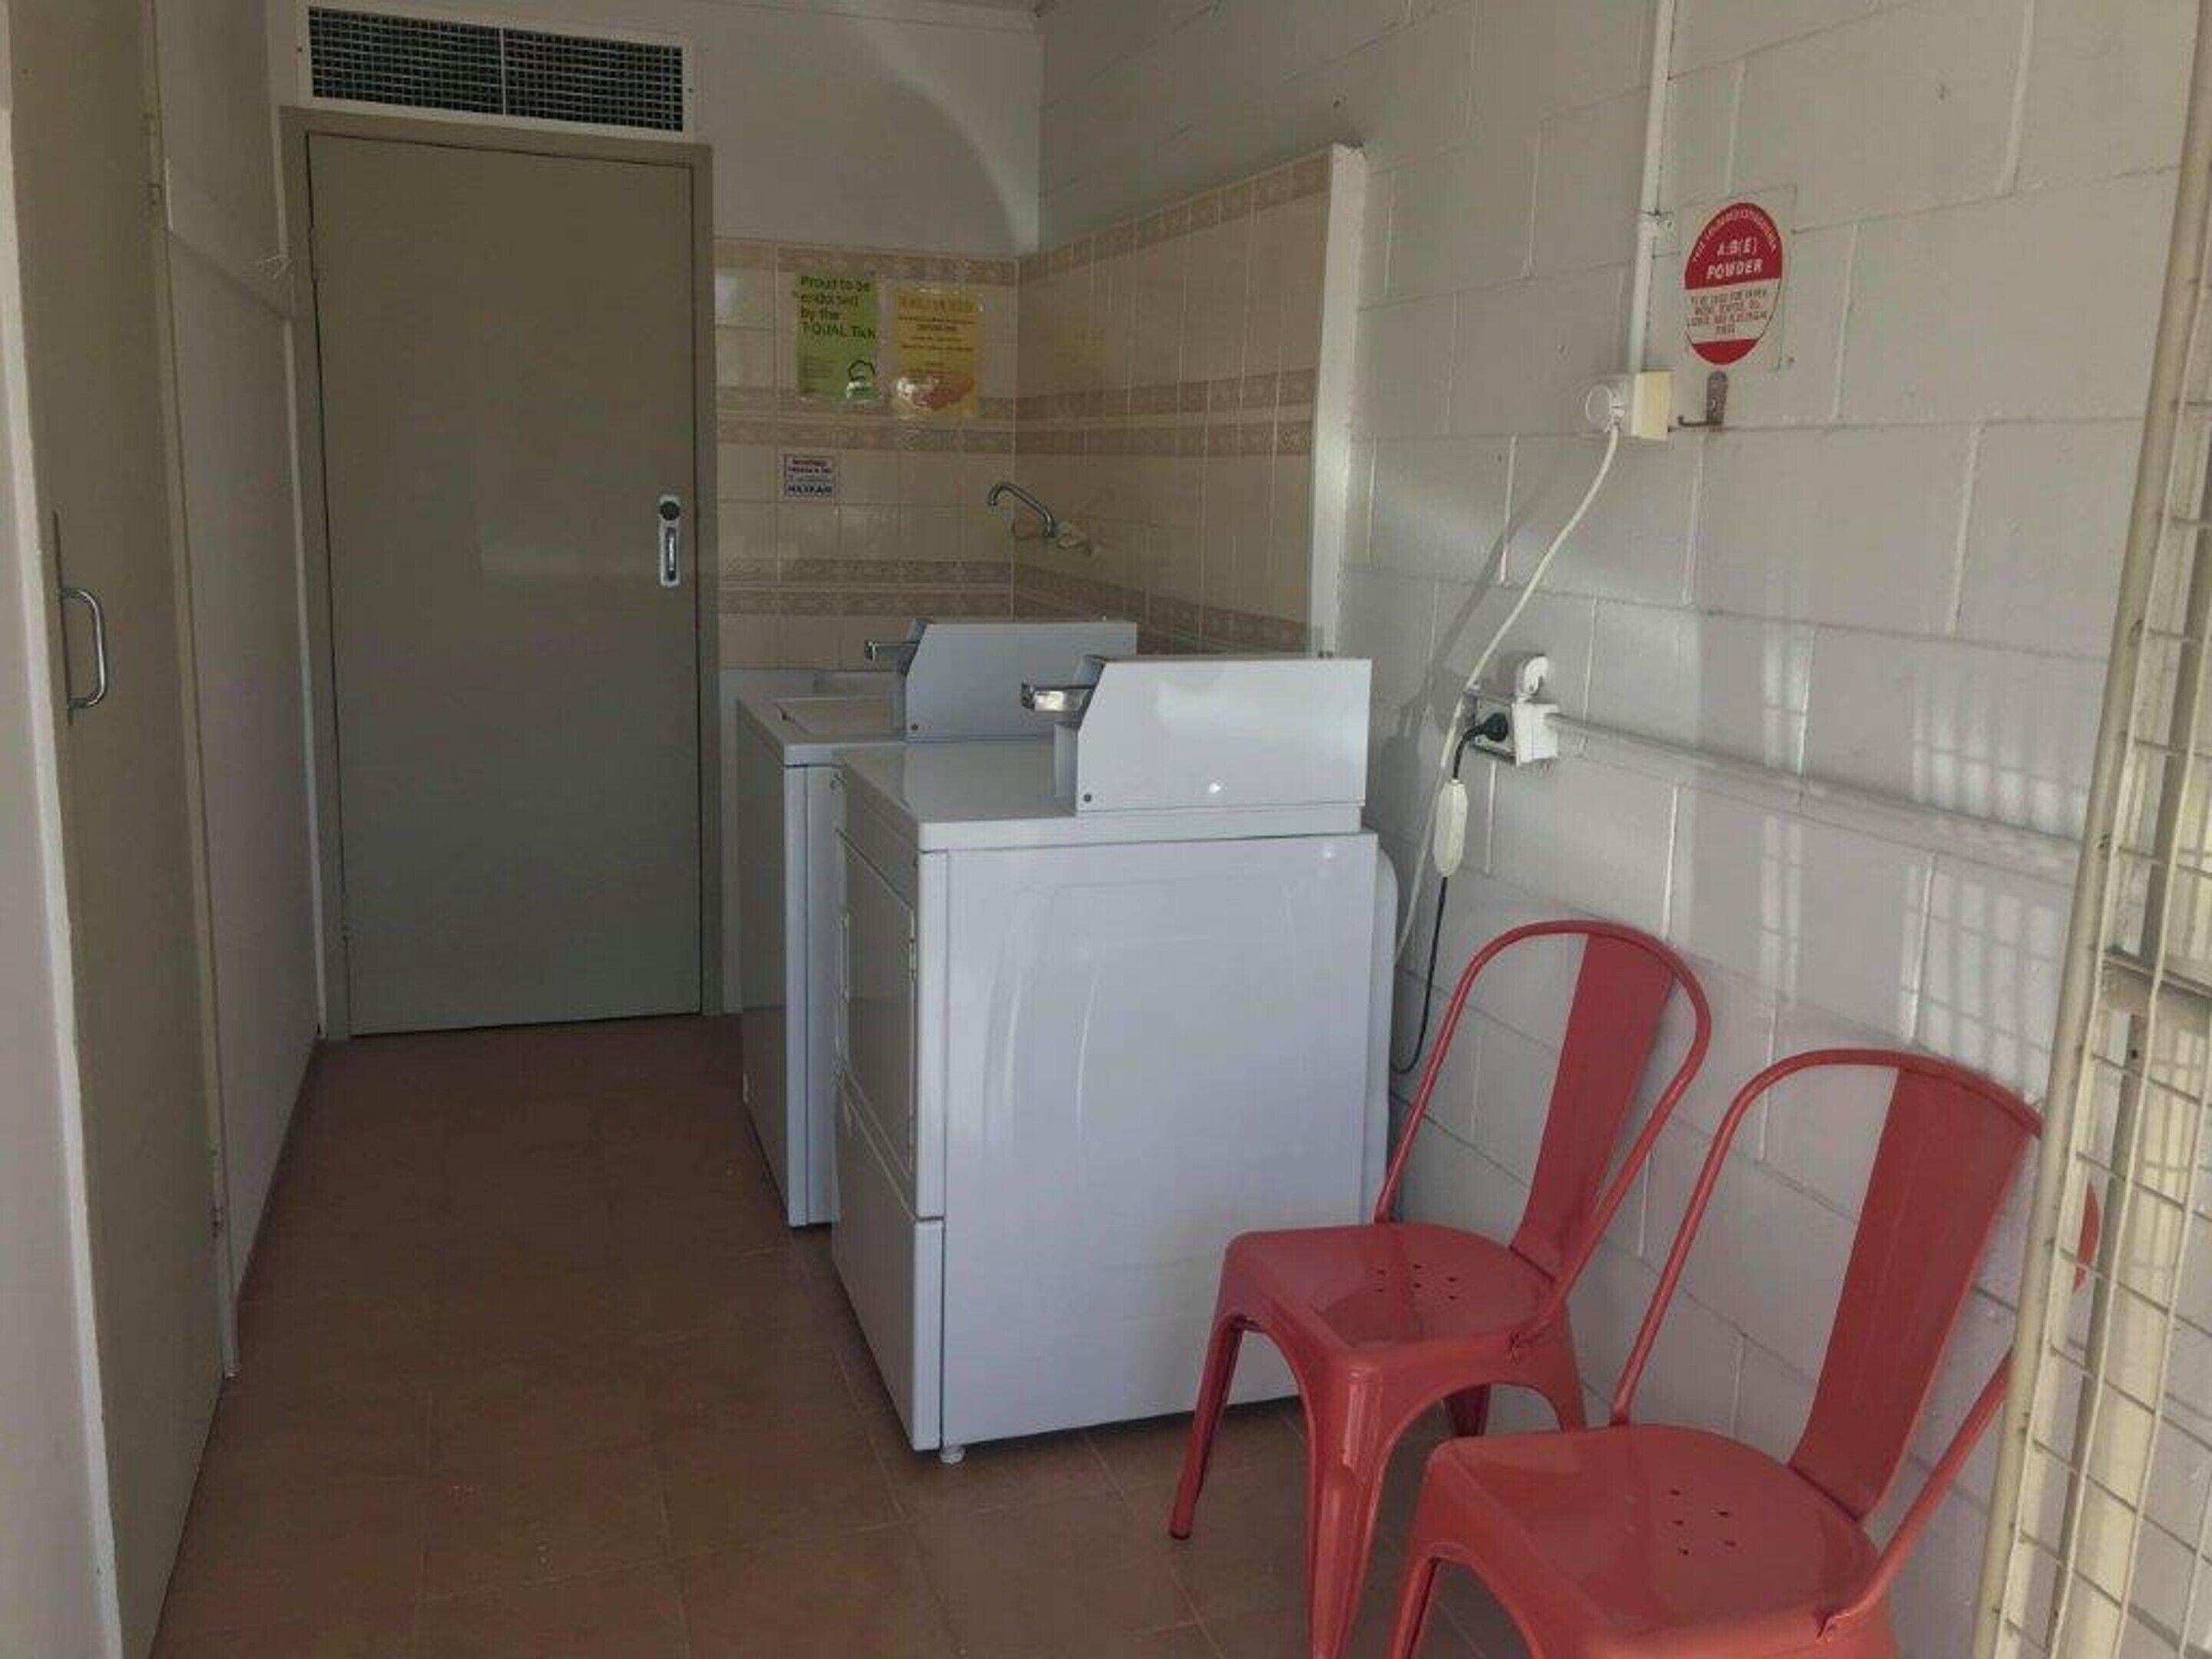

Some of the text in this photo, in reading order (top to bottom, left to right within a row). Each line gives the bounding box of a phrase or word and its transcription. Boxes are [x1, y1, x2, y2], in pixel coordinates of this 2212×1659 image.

[1706, 258, 1763, 280] POWDER
[800, 276, 837, 291] Proud
[800, 306, 840, 323] by the
